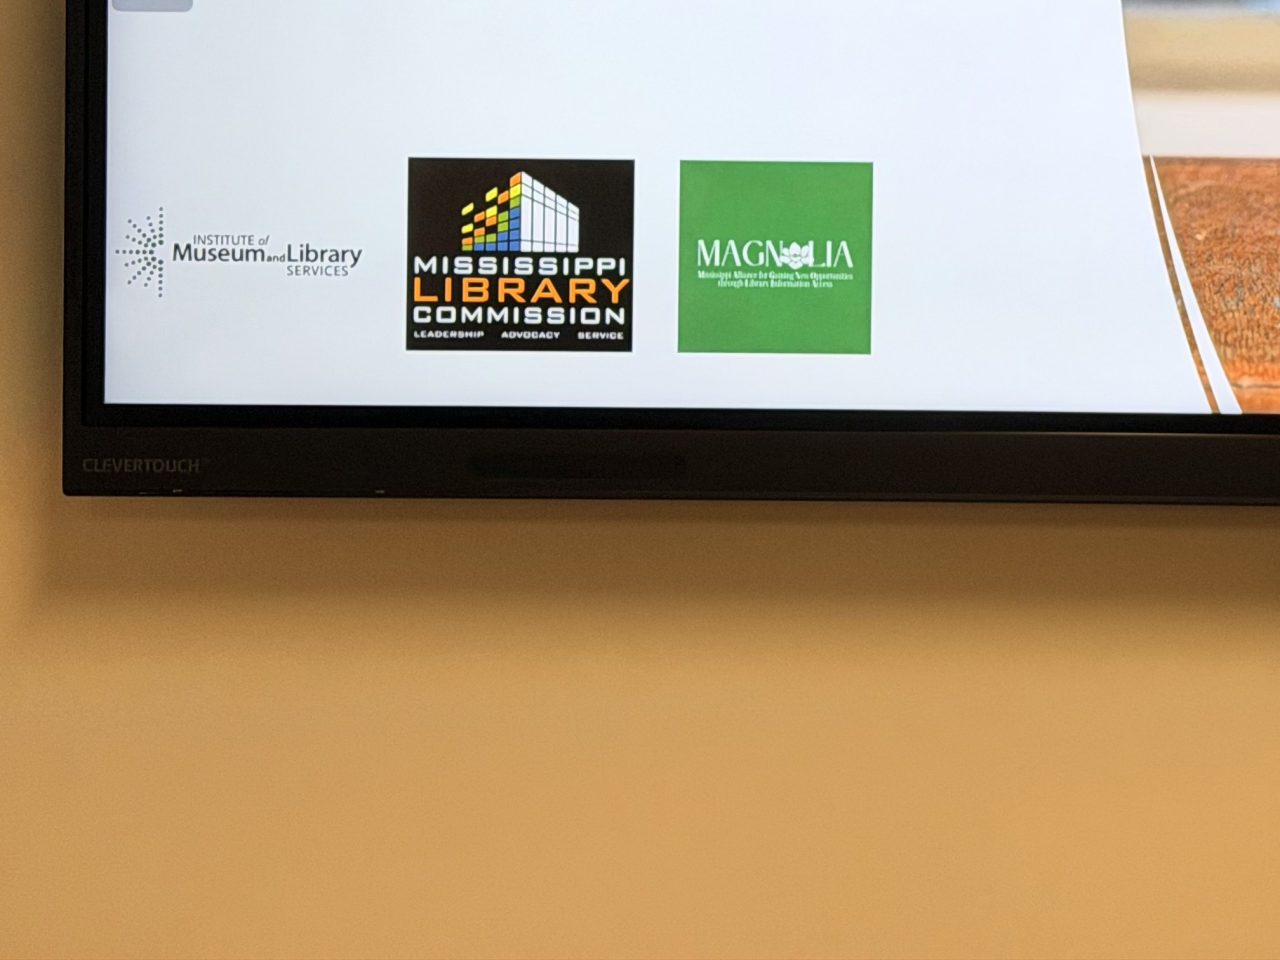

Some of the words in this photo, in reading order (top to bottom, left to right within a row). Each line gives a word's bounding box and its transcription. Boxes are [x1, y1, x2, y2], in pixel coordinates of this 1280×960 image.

[193, 234, 255, 246] INSTITUTE
[258, 234, 270, 246] of
[172, 243, 266, 263] Museum
[266, 253, 286, 263] and
[286, 243, 363, 268] Library
[286, 264, 349, 277] SERVICES
[413, 255, 626, 277] MISSISSIPPI
[413, 276, 631, 304] LIBRARY
[412, 305, 625, 325] COMMISSION
[413, 329, 485, 339] LEADERSHIP
[500, 330, 561, 339] ADVOCACY
[577, 331, 625, 340] SERVICE
[81, 457, 201, 473] CLEVERTOUCH
